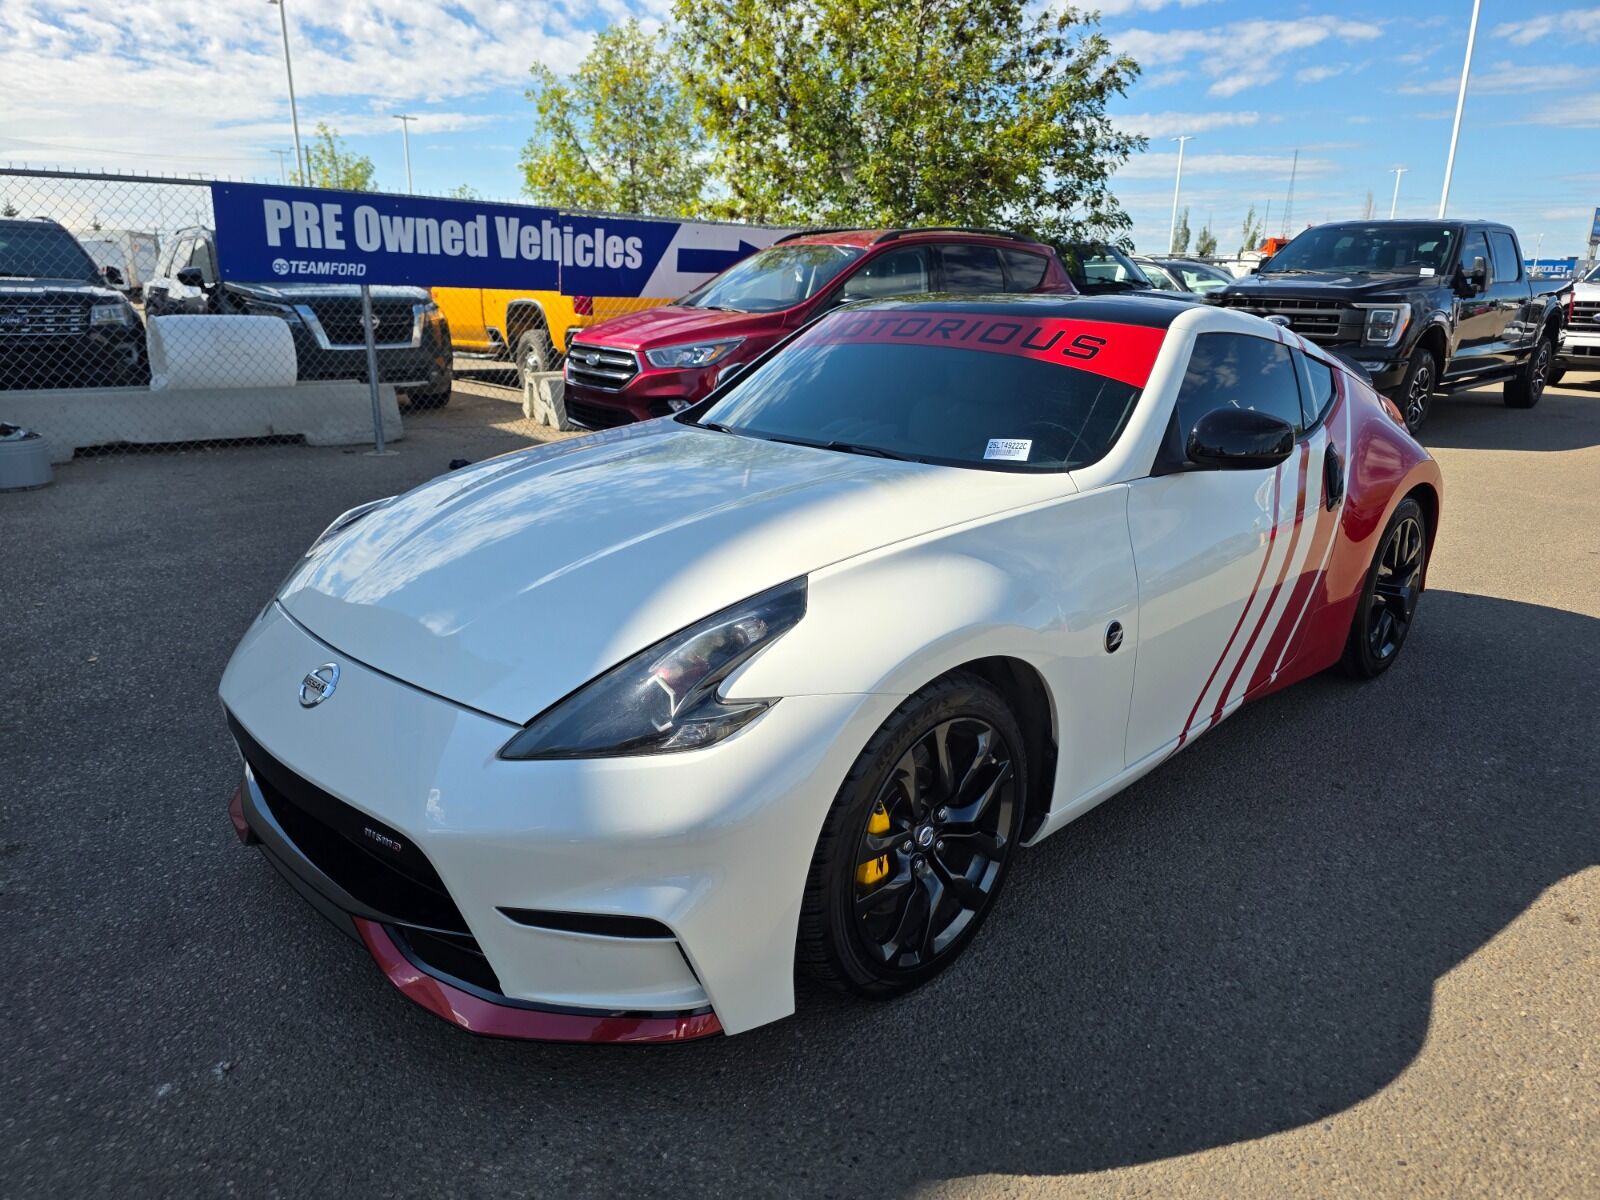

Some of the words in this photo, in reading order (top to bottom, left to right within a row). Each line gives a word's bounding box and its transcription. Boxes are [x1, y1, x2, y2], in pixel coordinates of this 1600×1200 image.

[263, 199, 346, 250] PRE
[354, 204, 488, 258] Owned
[495, 216, 643, 270] Vehicles
[830, 318, 1107, 361] OTORIOUS
[304, 675, 328, 694] SSAN
